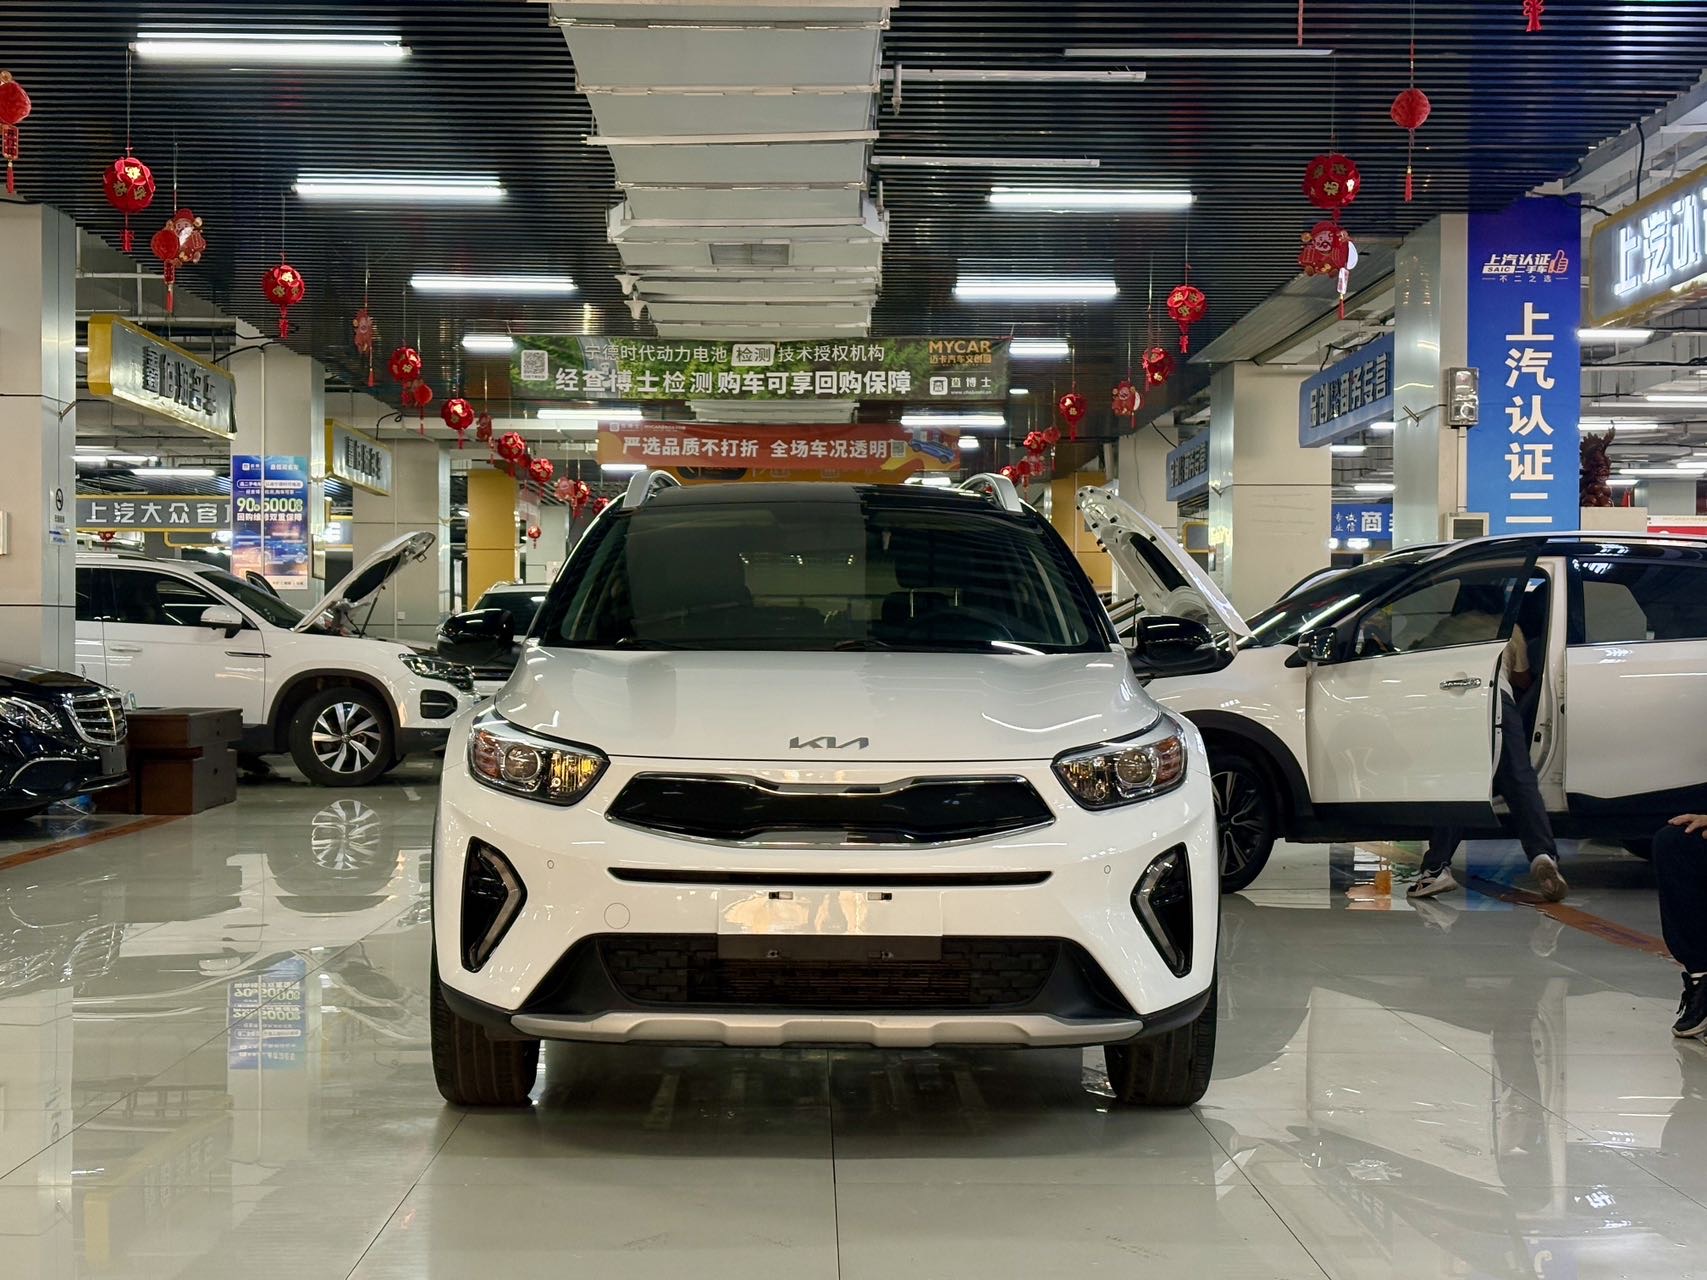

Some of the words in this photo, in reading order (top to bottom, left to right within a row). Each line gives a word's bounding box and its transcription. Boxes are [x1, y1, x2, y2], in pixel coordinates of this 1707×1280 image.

[1484, 253, 1551, 265] 上汽认证
[1515, 266, 1548, 274] 二手车
[1499, 274, 1552, 283] 不二之选
[584, 344, 728, 364] 宁德时代动力电池
[735, 346, 772, 363] 检测
[777, 344, 885, 363] 技术授权机构
[929, 340, 993, 354] MYCAR
[950, 376, 993, 388] 查博士
[622, 436, 759, 459] 严选品质不打折
[770, 439, 888, 459] 全场车况透明
[1361, 511, 1393, 533] 商
[789, 736, 869, 750] KIA
